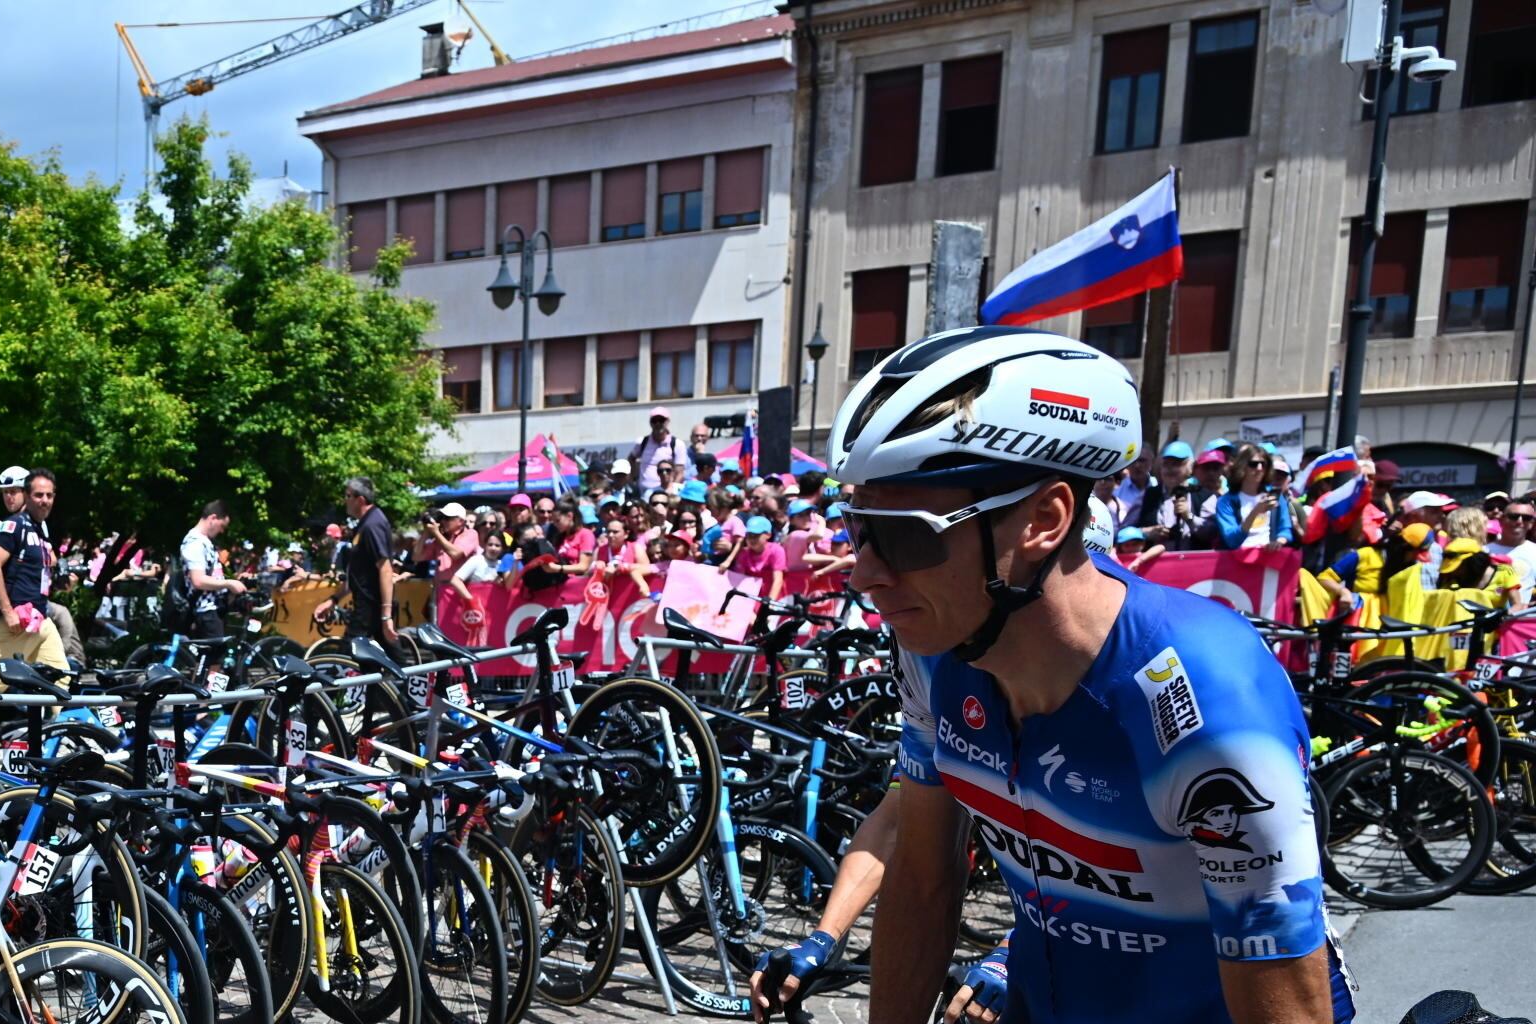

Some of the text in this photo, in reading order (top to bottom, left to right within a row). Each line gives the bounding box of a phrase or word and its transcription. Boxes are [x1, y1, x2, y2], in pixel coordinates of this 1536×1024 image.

[1029, 401, 1088, 425] SOUDAL
[939, 422, 1122, 474] SPECIALIZED
[1335, 653, 1349, 678] 122
[786, 679, 803, 708] 102
[1169, 675, 1200, 731] SAFETY
[1156, 685, 1181, 745] JOGGER
[292, 728, 306, 751] 83
[937, 714, 1008, 776] Ekopak
[1311, 737, 1365, 771] UBE
[1091, 777, 1107, 787] UCI
[1397, 757, 1478, 802] EWMEN
[26, 851, 56, 891] 157
[1198, 850, 1283, 874] POLEON
[270, 856, 300, 927] RESERVE
[1012, 886, 1167, 954] ICK-STEP
